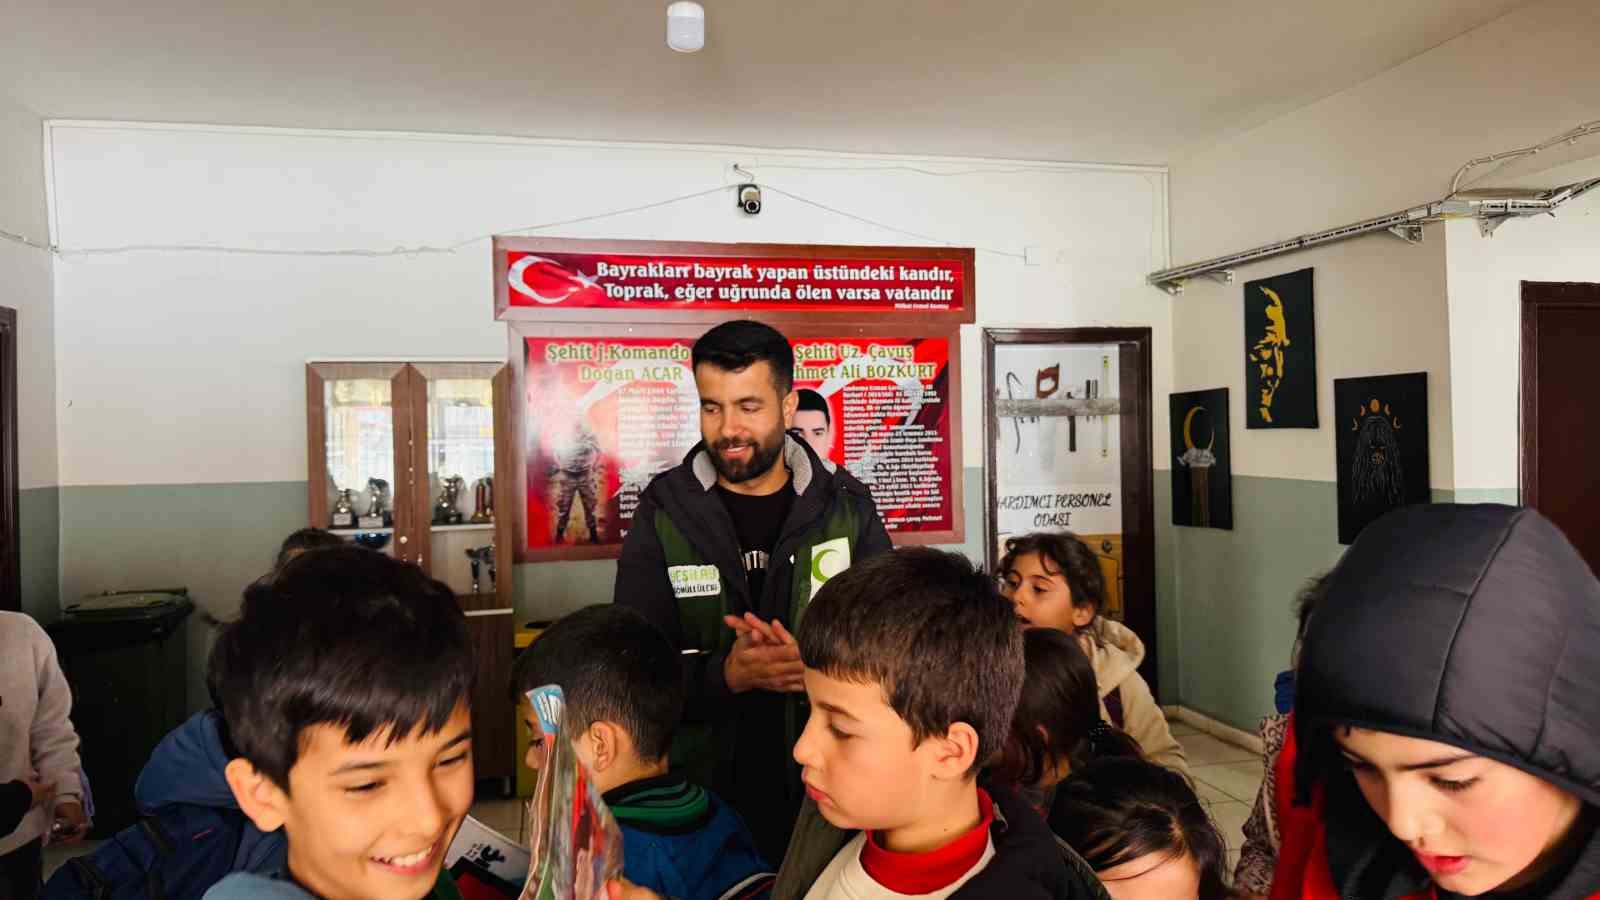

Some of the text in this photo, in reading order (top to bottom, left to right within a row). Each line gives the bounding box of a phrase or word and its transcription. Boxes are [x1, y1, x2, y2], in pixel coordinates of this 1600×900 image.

[694, 263, 753, 281] bayrak
[757, 267, 808, 282] yapan
[814, 265, 895, 281] üstündeki
[899, 266, 954, 283] kandır,
[604, 283, 954, 302] Toprak, eğer uğrunda ölen varsa vatandır
[547, 344, 593, 362] Şehit
[795, 344, 913, 361] Şehit Uz. Çavuş
[641, 366, 684, 381] ACAR
[795, 363, 936, 379] hmet Ali BOZKURT
[1055, 492, 1111, 508] PERSONEL
[1033, 512, 1072, 527] ODASI
